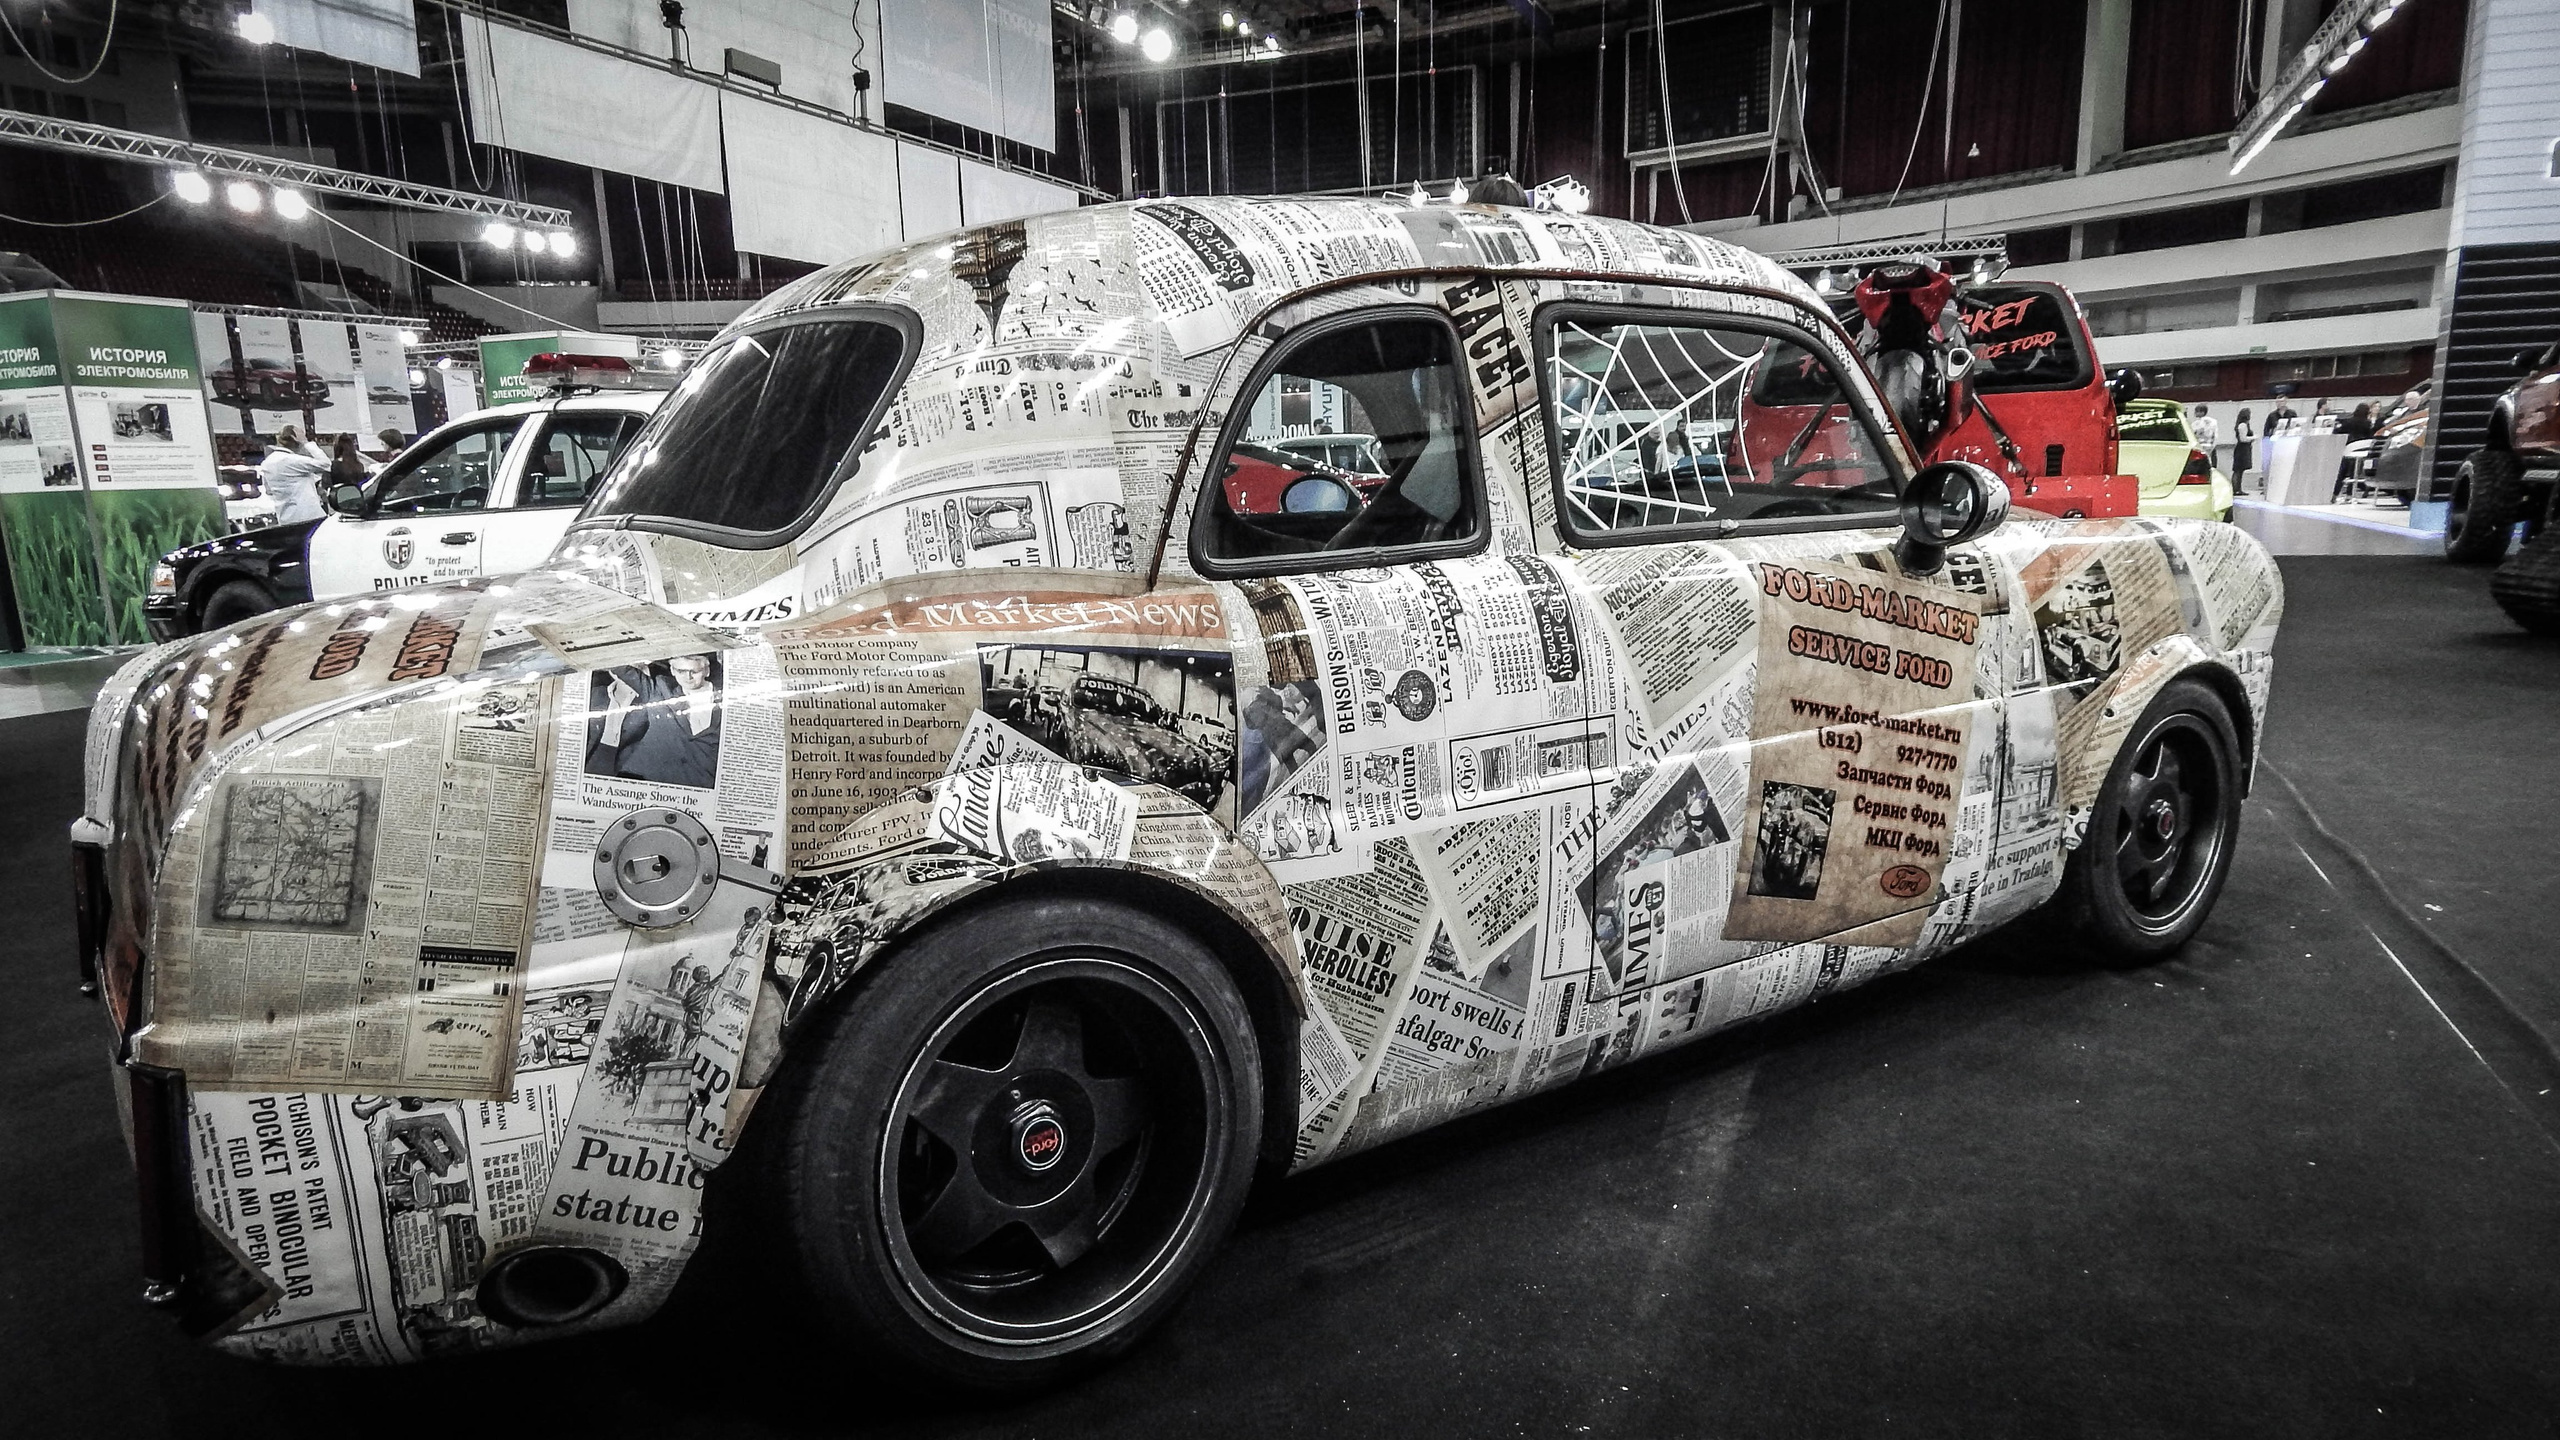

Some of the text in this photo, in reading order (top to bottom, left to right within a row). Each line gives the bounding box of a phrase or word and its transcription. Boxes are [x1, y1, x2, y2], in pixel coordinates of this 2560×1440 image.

[90, 347, 167, 364] ИСТОРИЯ
[2011, 331, 2057, 354] FORD
[77, 365, 189, 379] ЭЛЕКТРОМОБИЛЯ
[1127, 409, 1158, 429] The
[434, 567, 447, 577] and
[449, 568, 456, 577] to
[437, 556, 461, 567] protect
[1097, 600, 1221, 630] News
[1760, 562, 1980, 645] FORD-MARKET
[781, 651, 807, 662] The
[812, 651, 842, 661] Ford
[846, 651, 886, 661] Motor
[814, 639, 919, 649] Motor Company
[1348, 633, 1361, 666] BENSON'S
[1420, 589, 1453, 703] LAZENBY'S
[1554, 626, 1576, 679] Royal
[1788, 624, 1953, 689] SERVICE FORD
[784, 665, 859, 678] (commonly
[916, 668, 929, 678] to
[932, 669, 946, 678] as
[1323, 619, 1356, 734] BENSON'S KEYLESS
[1487, 635, 1501, 696] LAZENBY'S
[1495, 634, 1509, 695] LAZENBY'S
[1503, 633, 1516, 694] LAZENBY'S
[1509, 633, 1523, 693] LAZENBY'S
[1517, 632, 1530, 692] LAZENBY'S
[1524, 631, 1538, 691] LAZENBY'S
[874, 682, 966, 695] is an American
[1606, 656, 1617, 710] EGERTON
[789, 697, 947, 712] multinational automaker
[789, 714, 965, 730] headquartered in Dearborn,
[1645, 704, 1708, 763] TIMES
[1790, 698, 1961, 745] www.ford-market.ru
[791, 732, 929, 747] Michigan, a suburb of
[1818, 726, 1958, 771] (812) 927-7770
[791, 750, 953, 766] Detroit. It was founded by
[791, 768, 832, 782] Henry
[836, 768, 867, 779] Ford
[869, 769, 892, 780] and
[1402, 745, 1423, 820] Cuticura
[1837, 760, 1952, 801] Запчасти Форд
[582, 782, 604, 795] The
[605, 785, 648, 801] Assange
[649, 790, 682, 803] Show:
[683, 794, 699, 806] the
[791, 788, 807, 798] on
[812, 786, 843, 798] June
[847, 787, 864, 799] 16,
[1160, 803, 1173, 811] 8%
[1343, 755, 1360, 832] SLEEP & REST
[1382, 791, 1396, 825] MOTHERS
[791, 804, 850, 817] company
[882, 814, 917, 831] FPV.
[1364, 792, 1379, 828] BABIES
[1853, 794, 1947, 829] Сервис Форд
[791, 821, 817, 833] and
[878, 829, 914, 847] Ford
[1138, 820, 1200, 833] Kingdom, and
[1140, 834, 1202, 845] China. It also
[1556, 806, 1607, 862] THE
[1864, 826, 1941, 858] МКЦ Форд
[1452, 816, 1519, 876] ROOM IN THE
[1571, 810, 1642, 884] The comes together
[2005, 840, 2049, 866] support
[1238, 885, 1259, 897] Russia
[1888, 867, 1924, 894] Ford
[1997, 874, 2009, 891] in
[1253, 901, 1271, 911] Stock
[1618, 883, 1651, 1017] TIMES
[1311, 972, 1376, 1003] (or Husbands!
[1452, 1001, 1511, 1036] swells
[525, 1087, 537, 1112] HOW
[227, 1136, 253, 1179] FIELD
[572, 1136, 705, 1190] Public
[237, 1187, 261, 1217] AND
[248, 1097, 314, 1300] POCKET BINOCULAR
[304, 1177, 332, 1230] PATENT
[552, 1188, 680, 1232] statue
